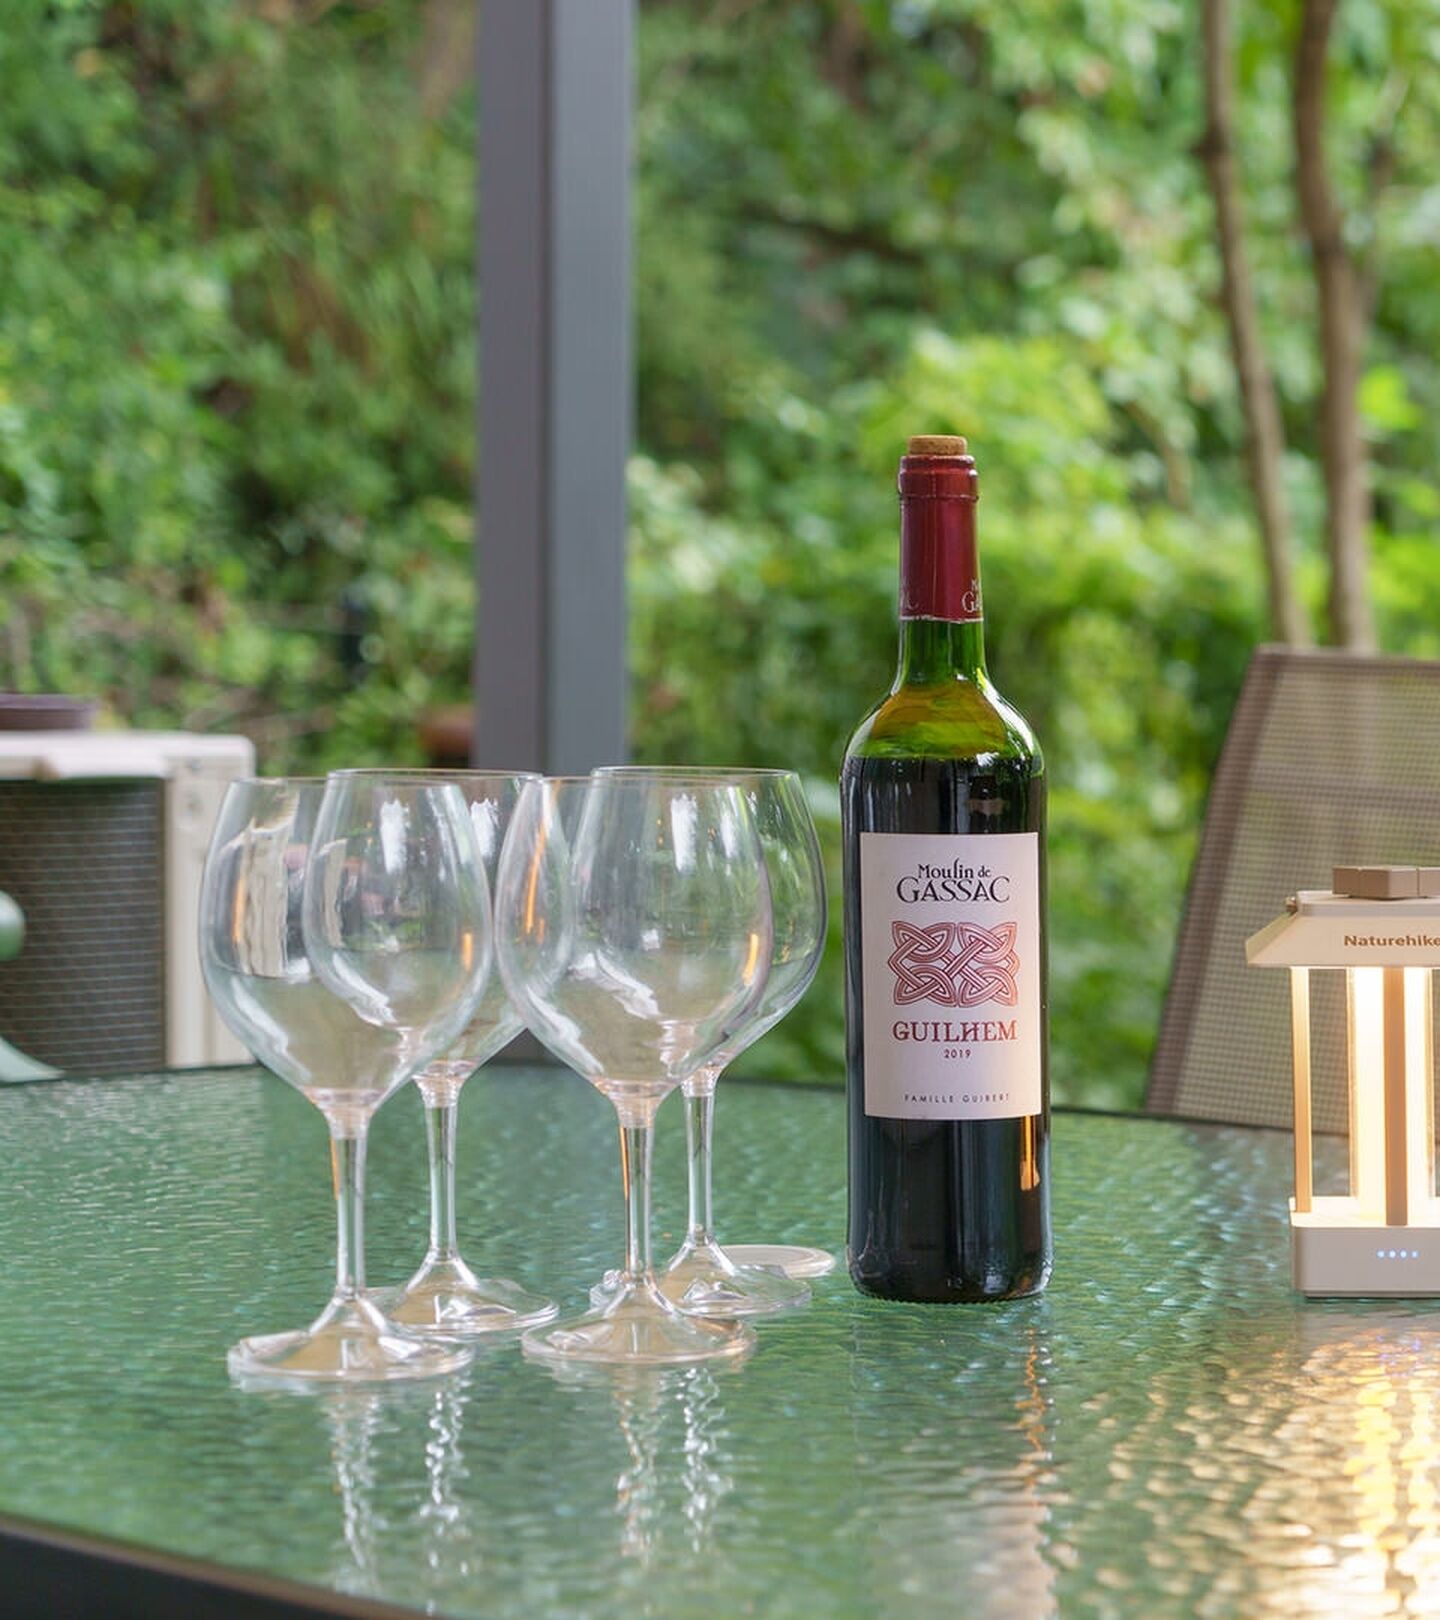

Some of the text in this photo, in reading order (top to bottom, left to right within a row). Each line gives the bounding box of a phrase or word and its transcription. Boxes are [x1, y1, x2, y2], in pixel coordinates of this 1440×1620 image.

[918, 858, 991, 879] Moulin de
[896, 876, 1010, 903] GASSAC
[892, 1020, 1018, 1042] GUILHEM
[943, 1048, 972, 1059] 2019
[904, 1094, 954, 1103] FAMILLE
